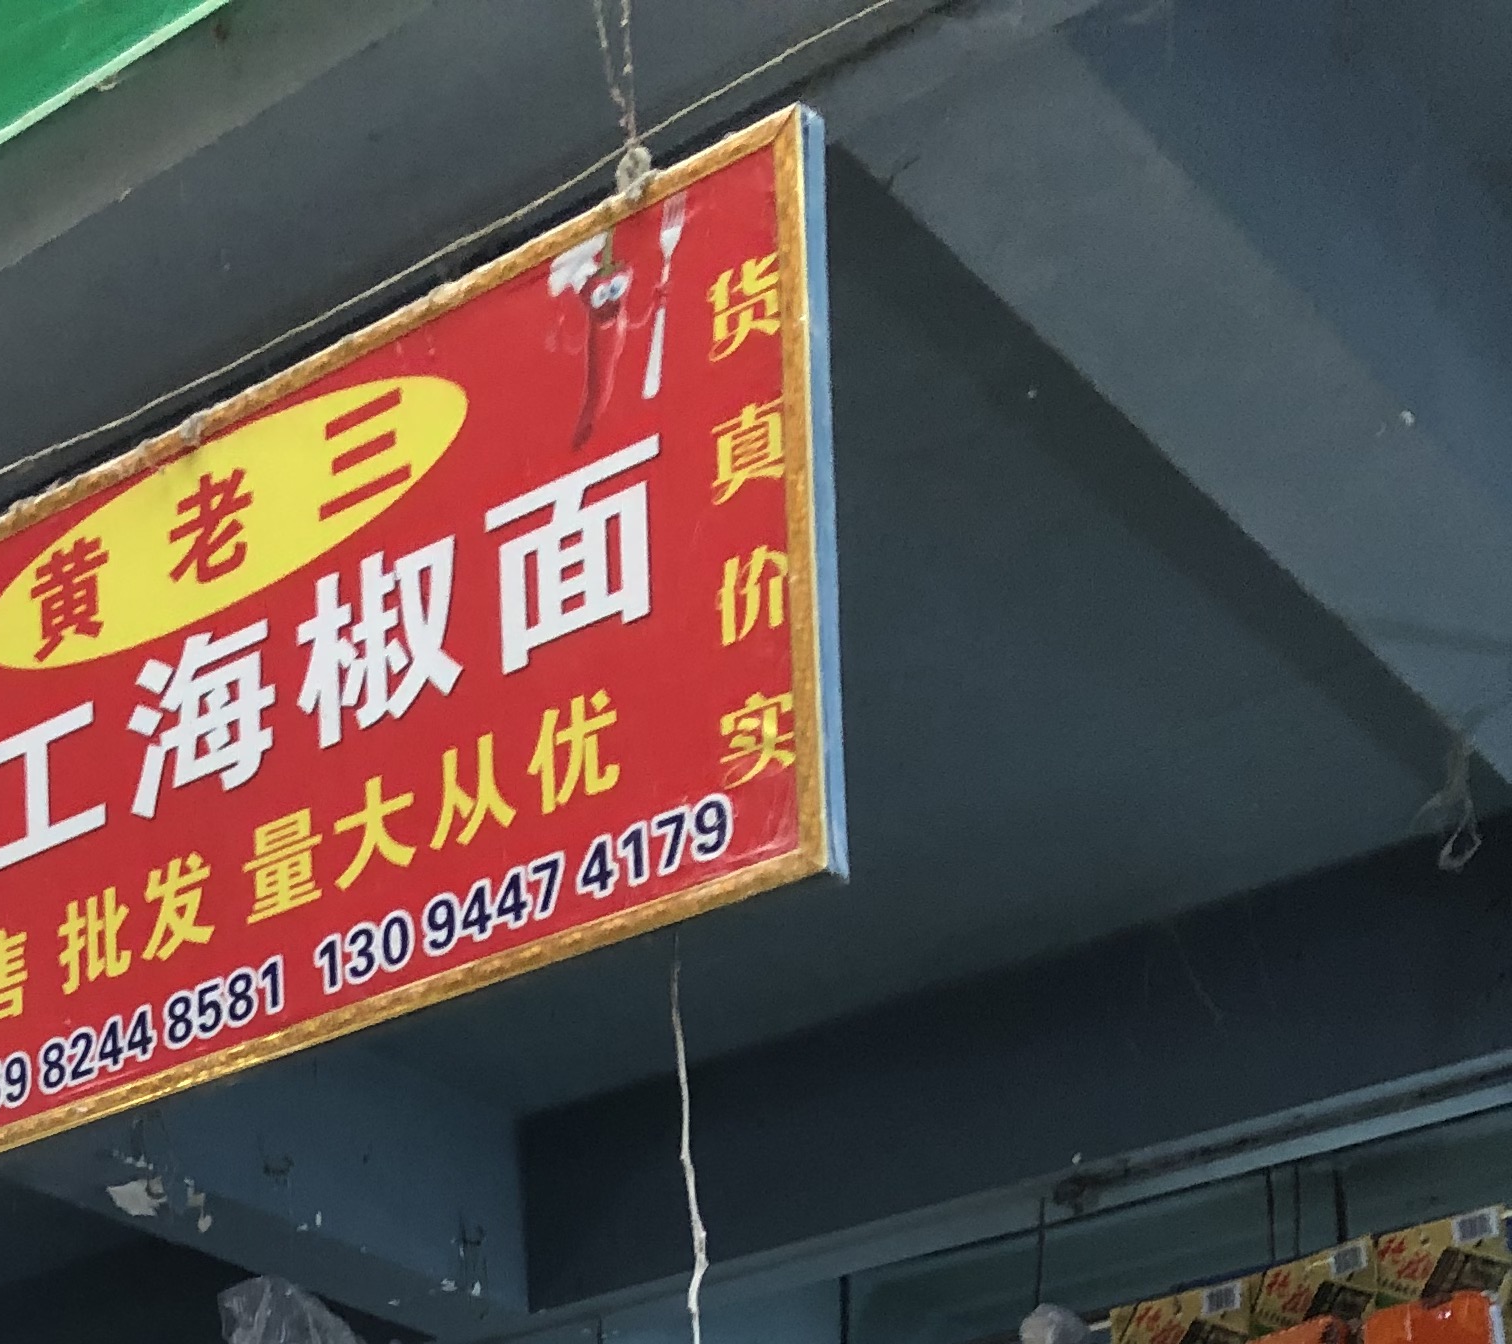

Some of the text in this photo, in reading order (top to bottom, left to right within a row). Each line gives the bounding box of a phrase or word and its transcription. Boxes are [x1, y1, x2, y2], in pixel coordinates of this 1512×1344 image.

[29, 387, 414, 658] 黄老三
[708, 250, 799, 788] 货真价实
[39, 1014, 155, 1097] 8244
[164, 963, 286, 1053] 8581
[317, 914, 411, 994] 130
[422, 856, 564, 960] 9447
[576, 794, 736, 902] 4179
[59, 852, 214, 995] 批发
[245, 689, 619, 924] 量大从优
